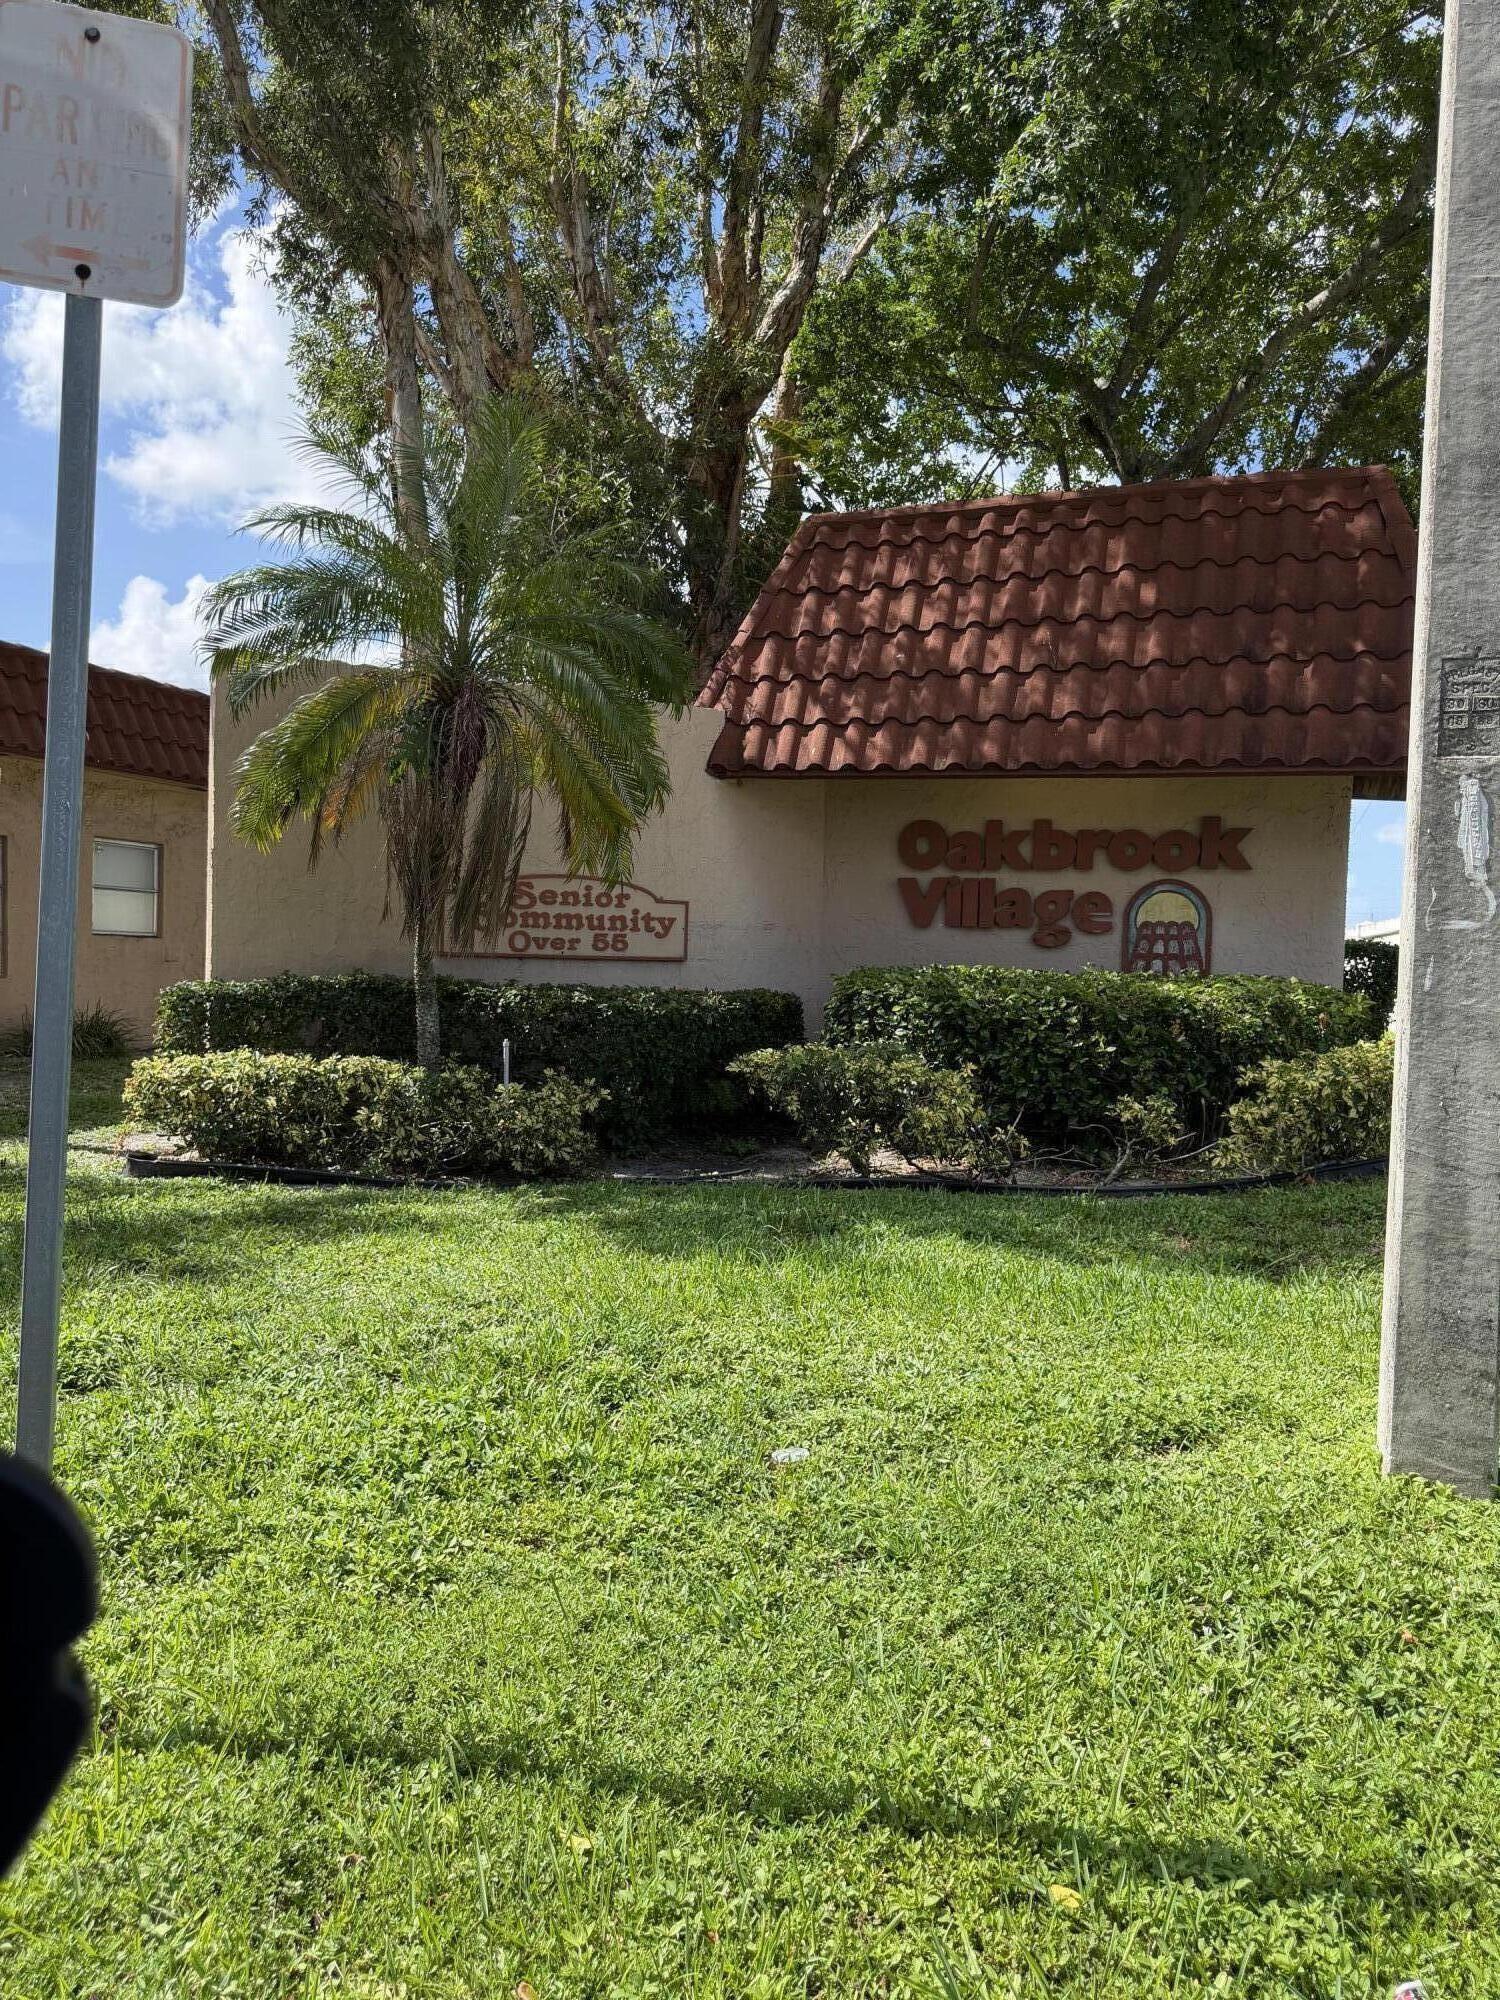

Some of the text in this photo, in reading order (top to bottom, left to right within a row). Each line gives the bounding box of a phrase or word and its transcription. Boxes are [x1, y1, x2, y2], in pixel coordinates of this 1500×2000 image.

[898, 816, 1255, 873] Oakbrook
[511, 881, 631, 910] Senior
[474, 907, 677, 939] ommunity
[897, 876, 1114, 949] Village
[508, 930, 629, 952] Over 55
